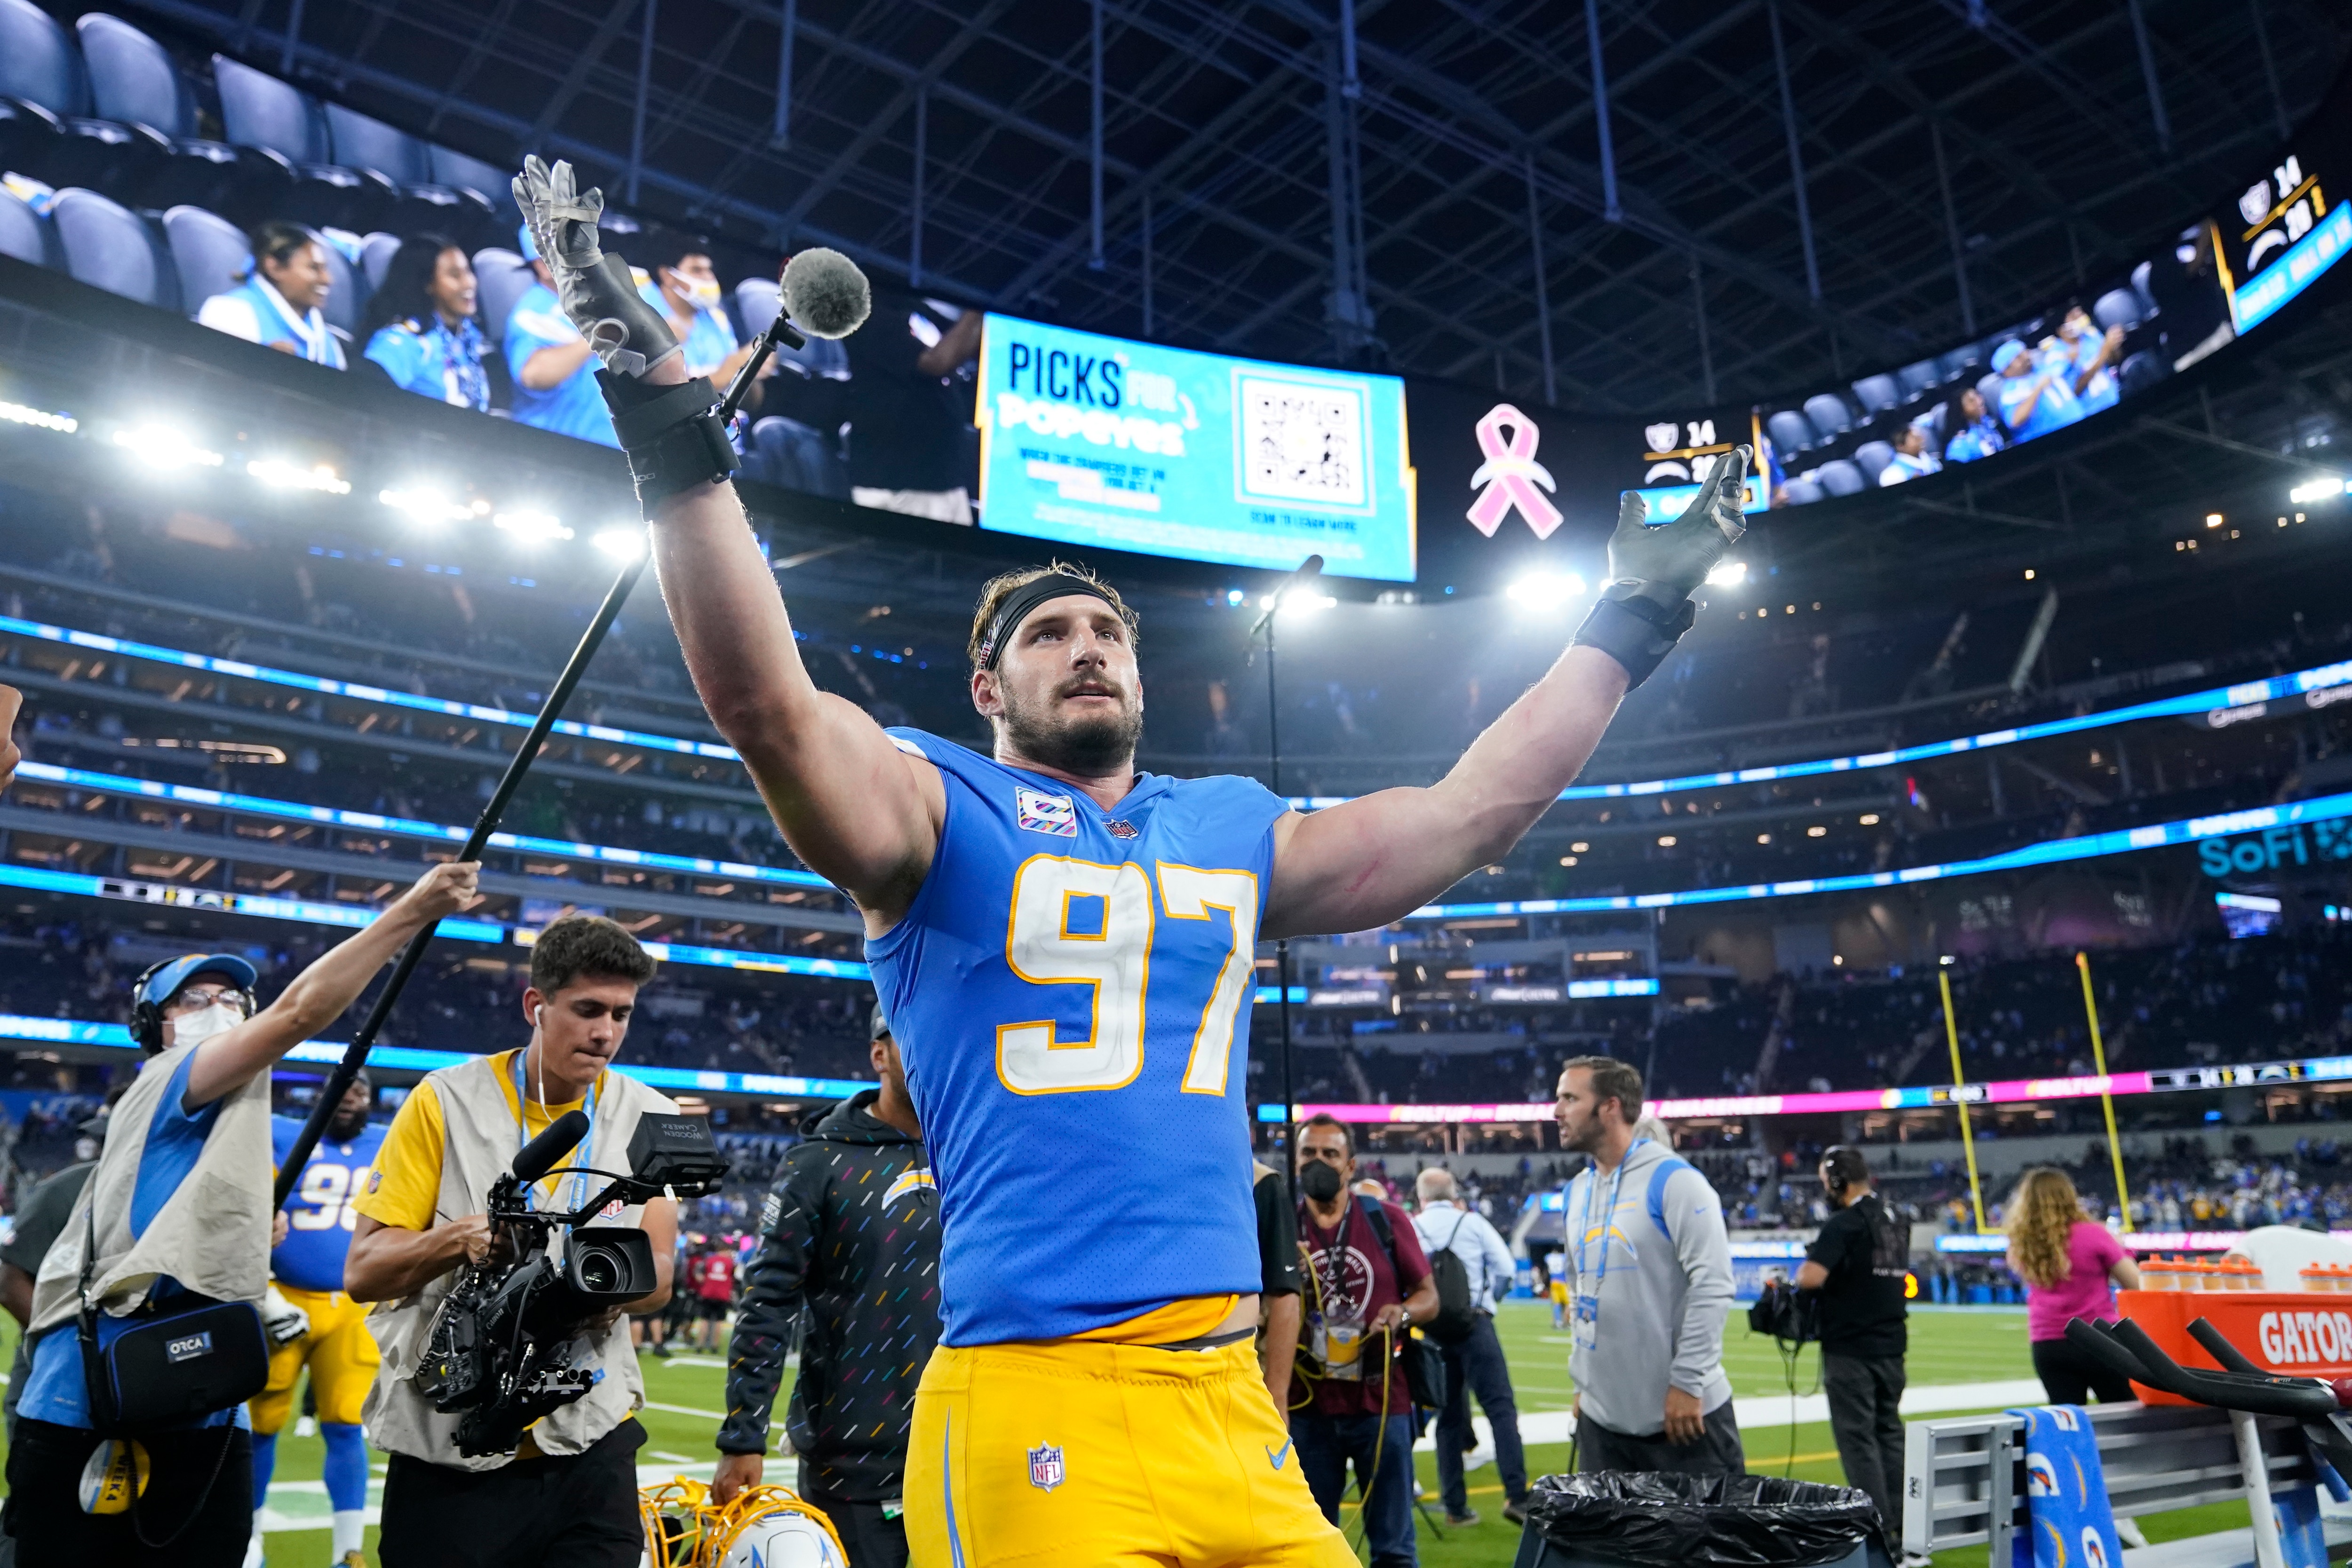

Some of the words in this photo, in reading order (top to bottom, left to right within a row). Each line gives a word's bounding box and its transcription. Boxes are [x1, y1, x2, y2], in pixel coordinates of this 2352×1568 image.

[1010, 342, 1120, 408] PICKS
[997, 392, 1185, 456] POPEYES
[1687, 419, 1716, 447] 14
[1021, 789, 1073, 824] C
[2197, 826, 2309, 878] SoFi
[995, 853, 1258, 1096] 97
[1494, 1104, 1556, 1121] BREA
[661, 1123, 697, 1132] CAMERA
[664, 1130, 703, 1139] WOODEN
[486, 1308, 504, 1330] Canon
[169, 1337, 204, 1354] ORCA
[2259, 1311, 2352, 1365] GATOR
[1034, 1465, 1060, 1483] NFL
